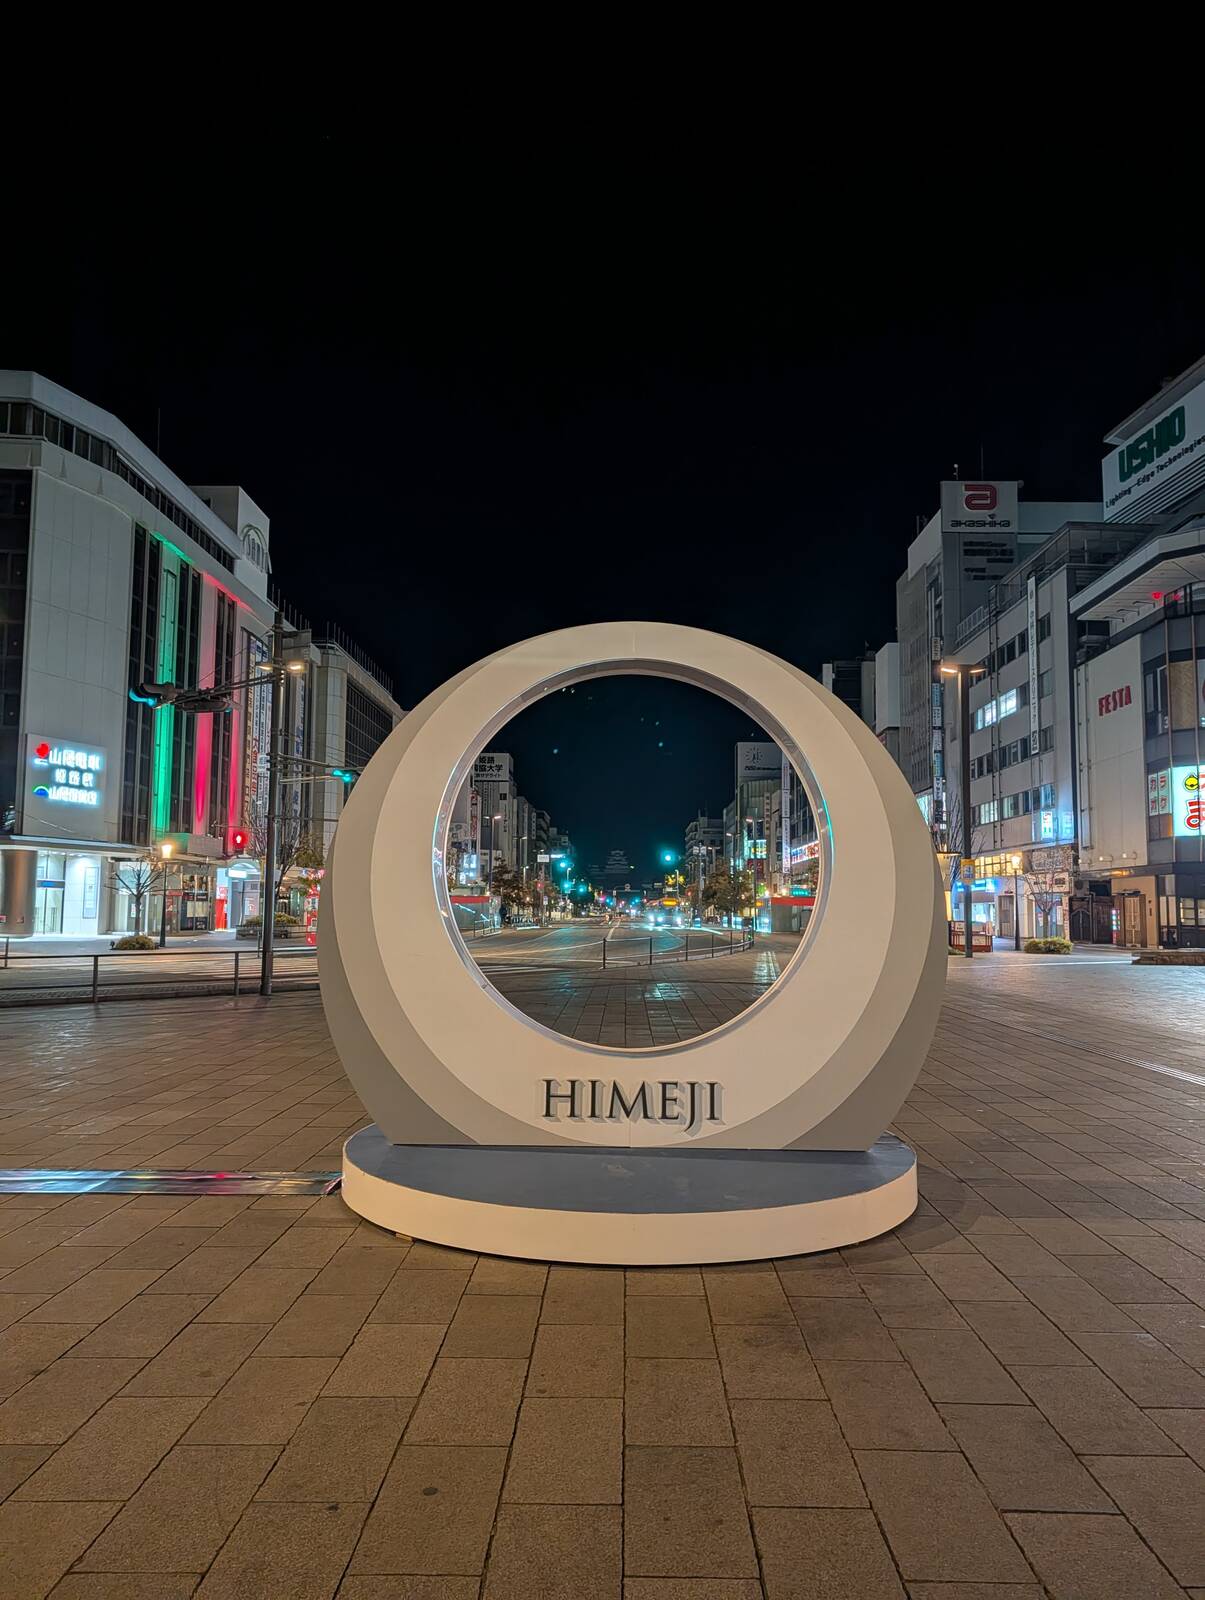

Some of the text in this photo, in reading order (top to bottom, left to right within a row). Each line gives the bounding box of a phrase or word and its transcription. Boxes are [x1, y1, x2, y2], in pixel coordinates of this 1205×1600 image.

[1118, 404, 1186, 483] USHIO
[950, 518, 1011, 528] akashika
[1098, 685, 1132, 716] FESTA
[542, 1079, 724, 1135] HIMEJI
